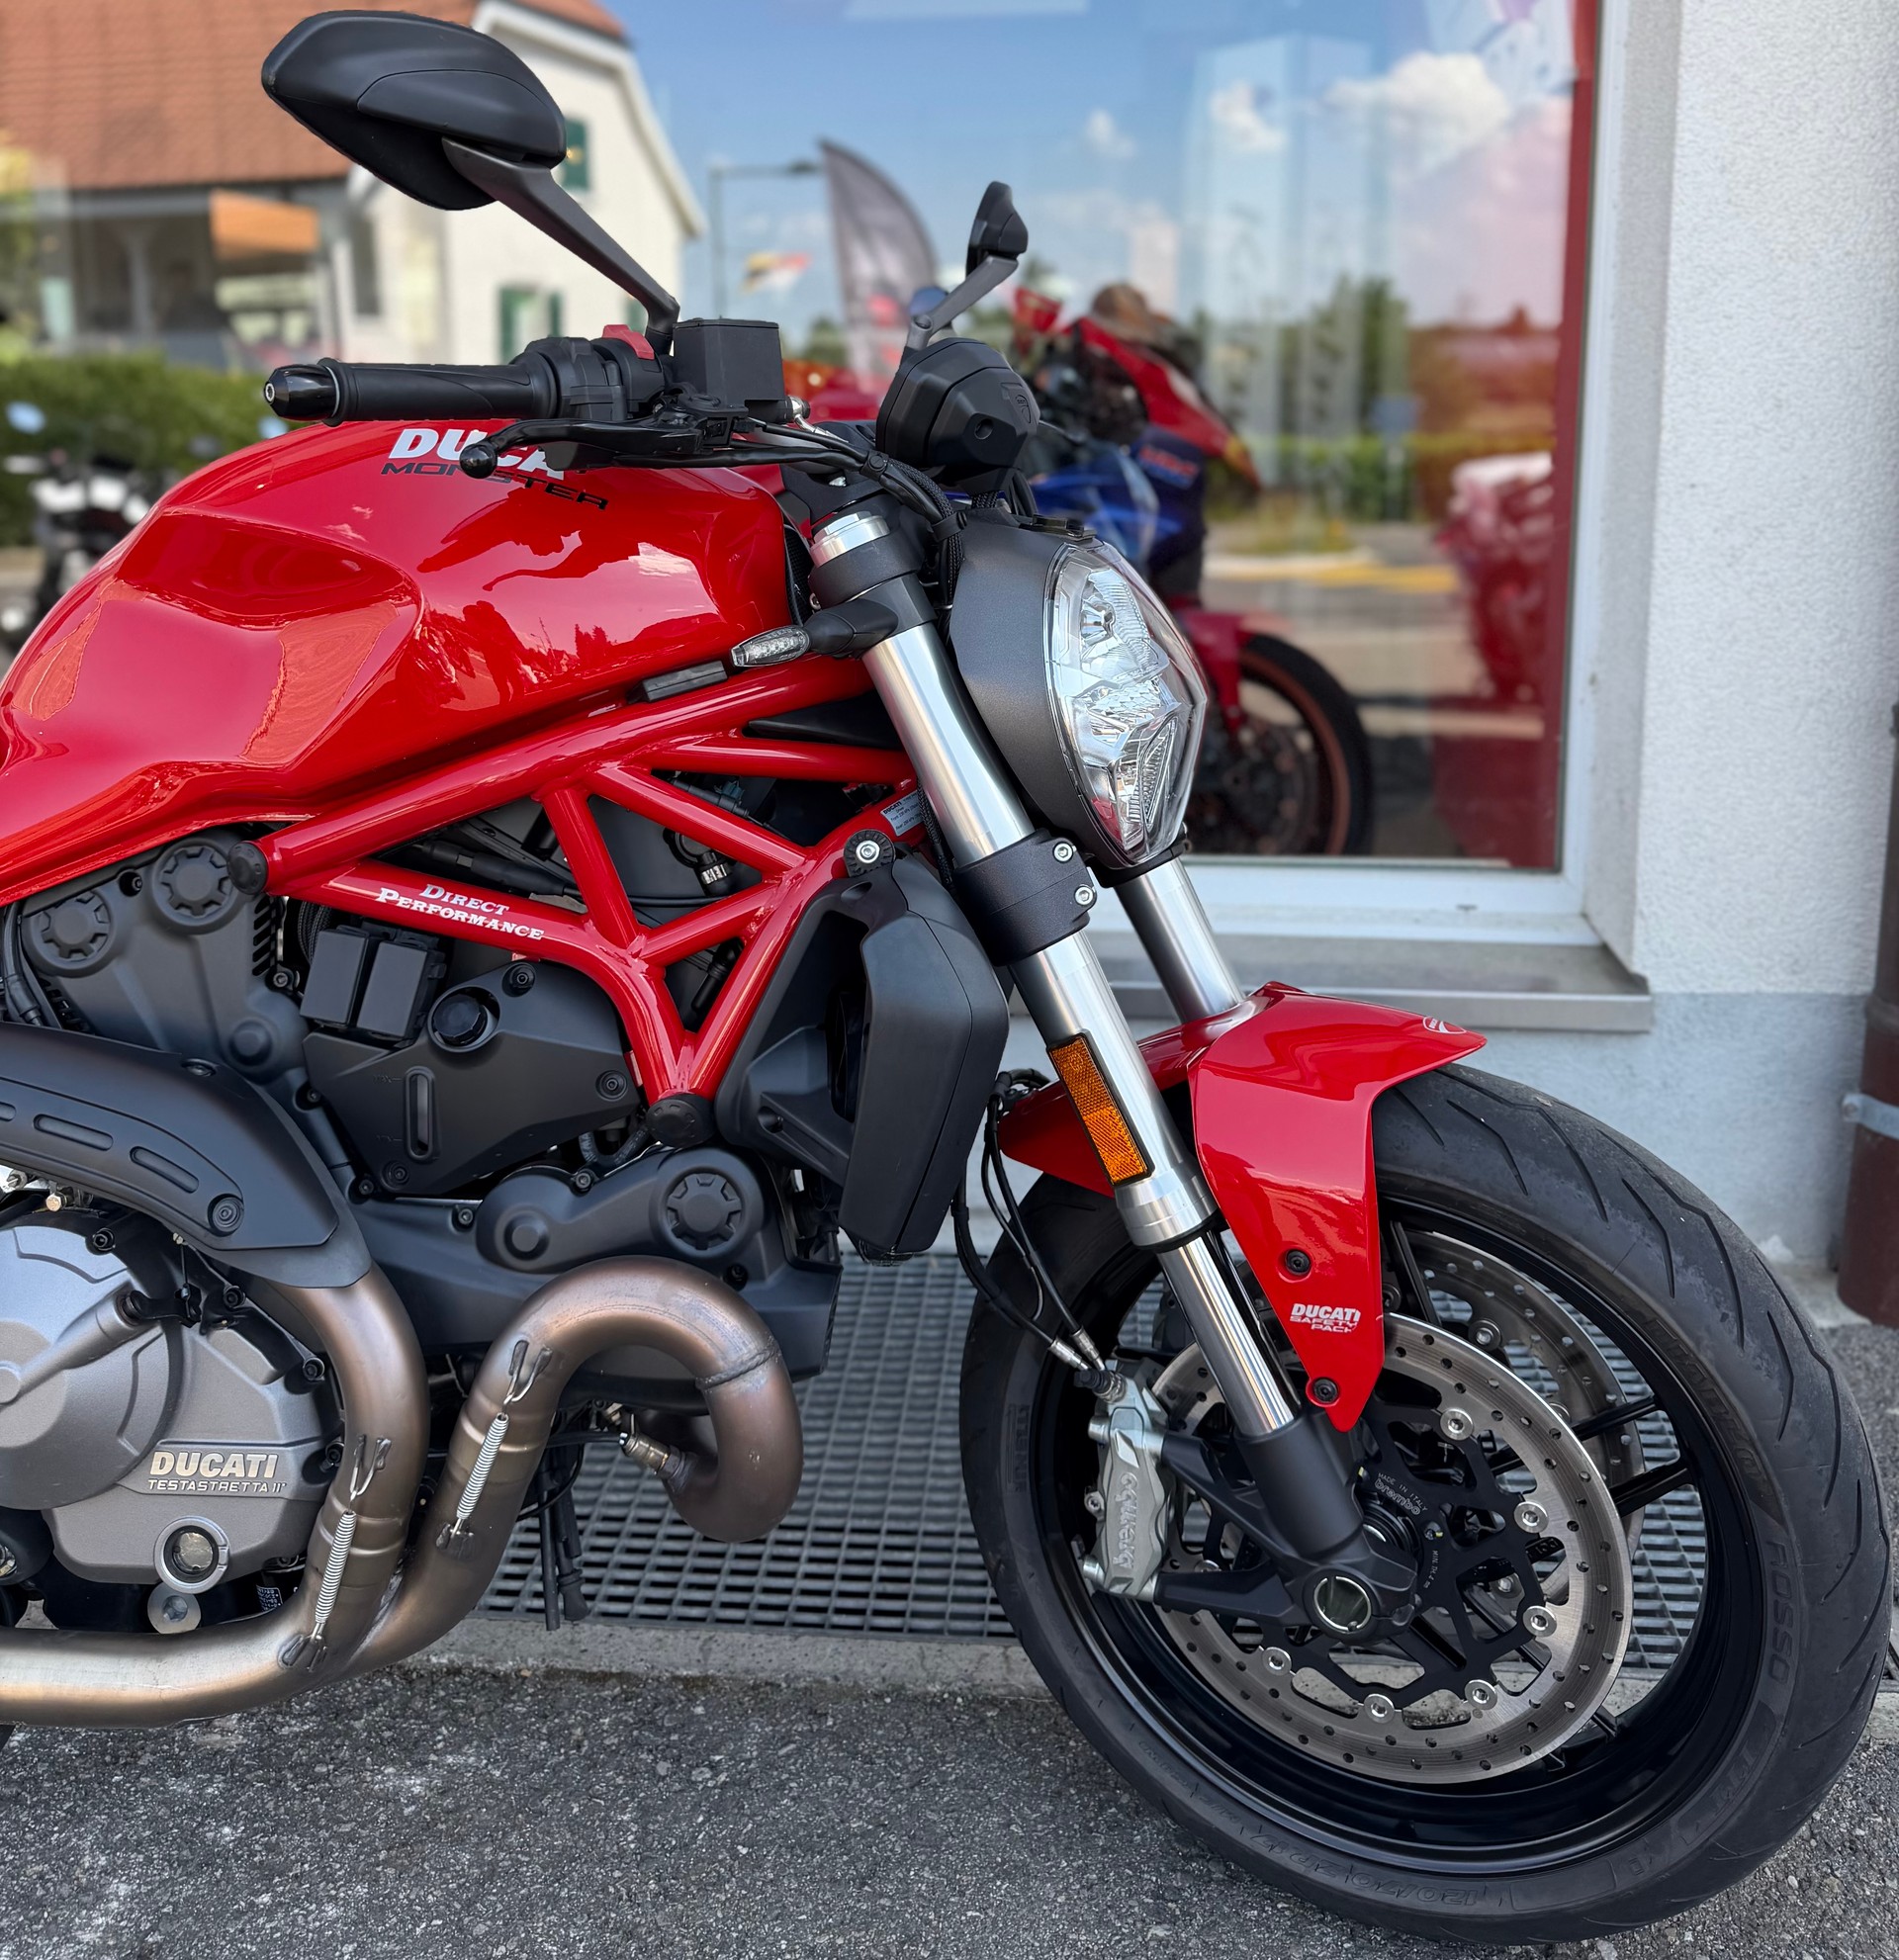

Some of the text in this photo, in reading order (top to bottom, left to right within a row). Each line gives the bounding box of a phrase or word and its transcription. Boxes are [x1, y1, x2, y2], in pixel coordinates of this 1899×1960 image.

[375, 887, 545, 940] PERFORMANCE
[419, 883, 510, 916] DIRECT
[1290, 1315, 1358, 1328] SAFETY
[1291, 1302, 1362, 1322] DUCATI
[150, 1451, 279, 1478] DUCATI
[148, 1479, 269, 1493] TESTASTRETTA
[1375, 1477, 1421, 1515] brembo
[1378, 1472, 1428, 1512] MADE IN ITALY
[1113, 1471, 1137, 1568] brembo
[1765, 1541, 1794, 1685] ROSSO
[1350, 1872, 1480, 1907] 120/70
